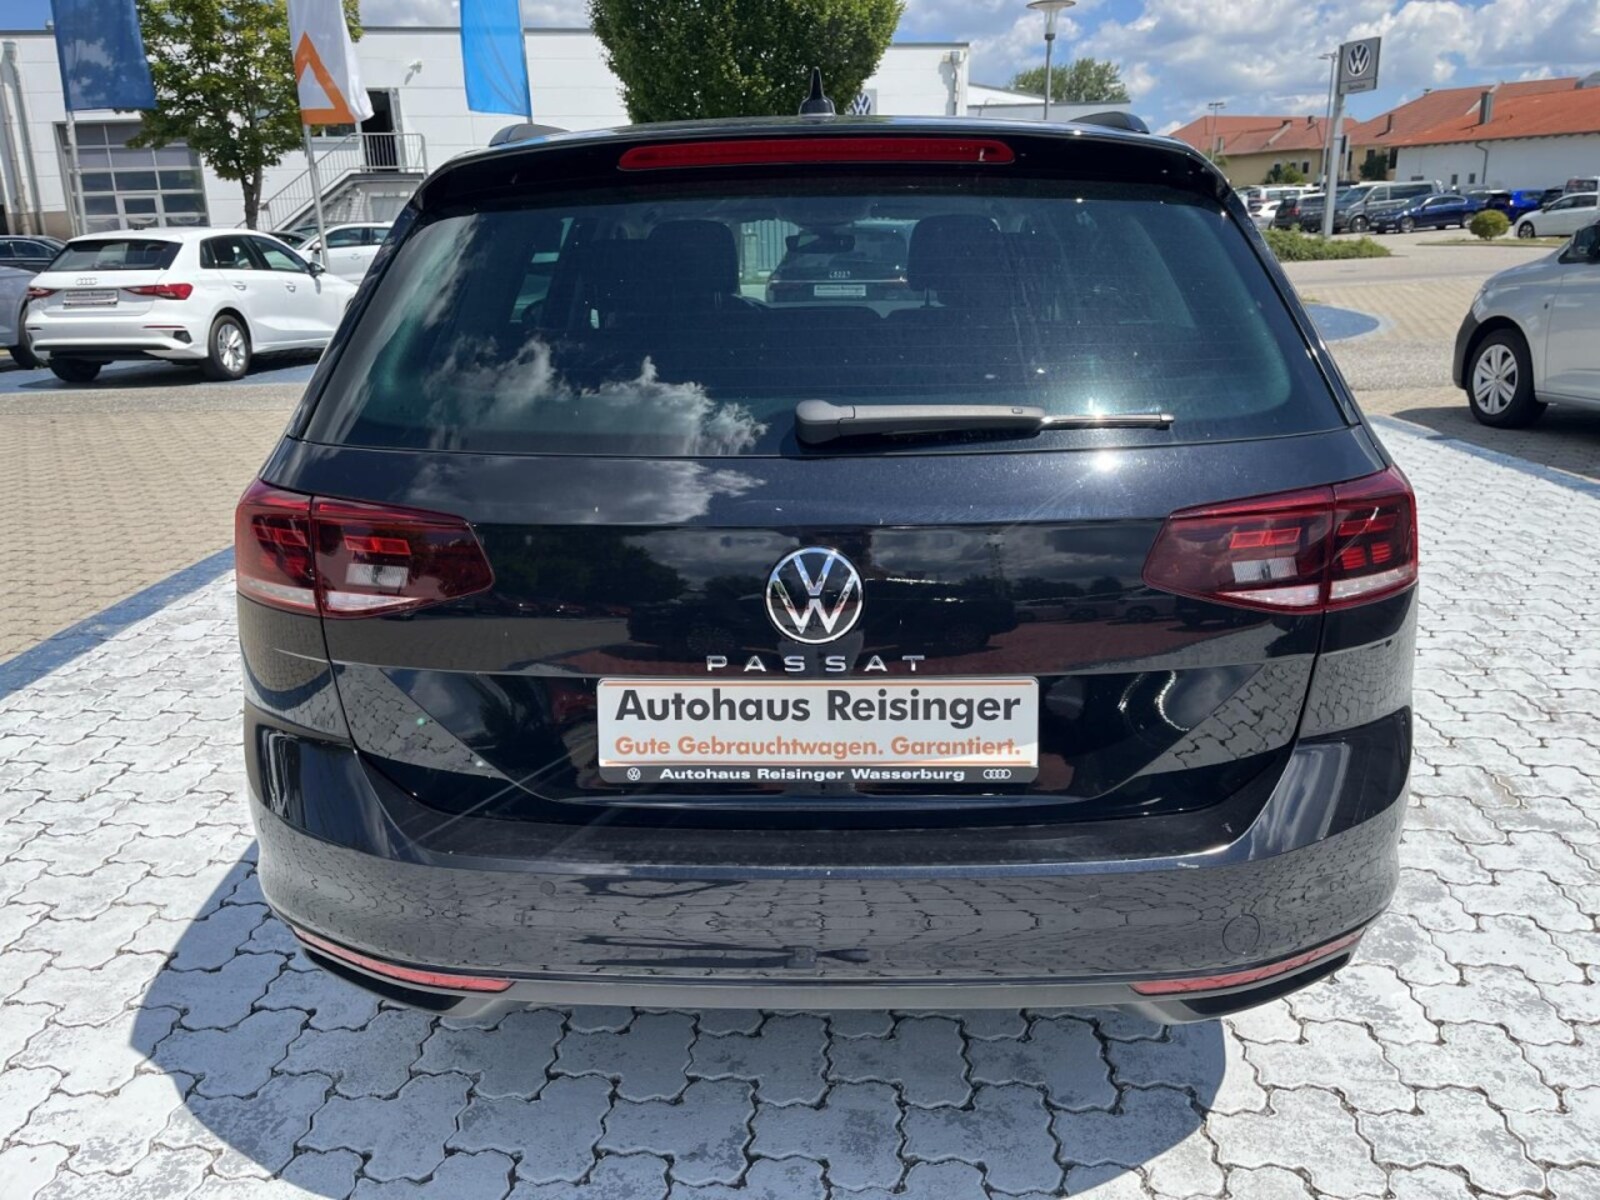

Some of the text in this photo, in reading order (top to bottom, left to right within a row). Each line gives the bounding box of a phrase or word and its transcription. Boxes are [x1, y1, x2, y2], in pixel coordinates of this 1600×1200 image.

[767, 548, 861, 641] VW
[706, 655, 925, 672] PASSAT
[614, 688, 1021, 730] Autohaus Reisinger
[614, 735, 1021, 760] Gute Gebrauchtwagen. Garantiert.
[659, 768, 751, 780] Autohaus
[756, 768, 844, 782] Reisinger
[850, 768, 965, 782] Wasserburg
